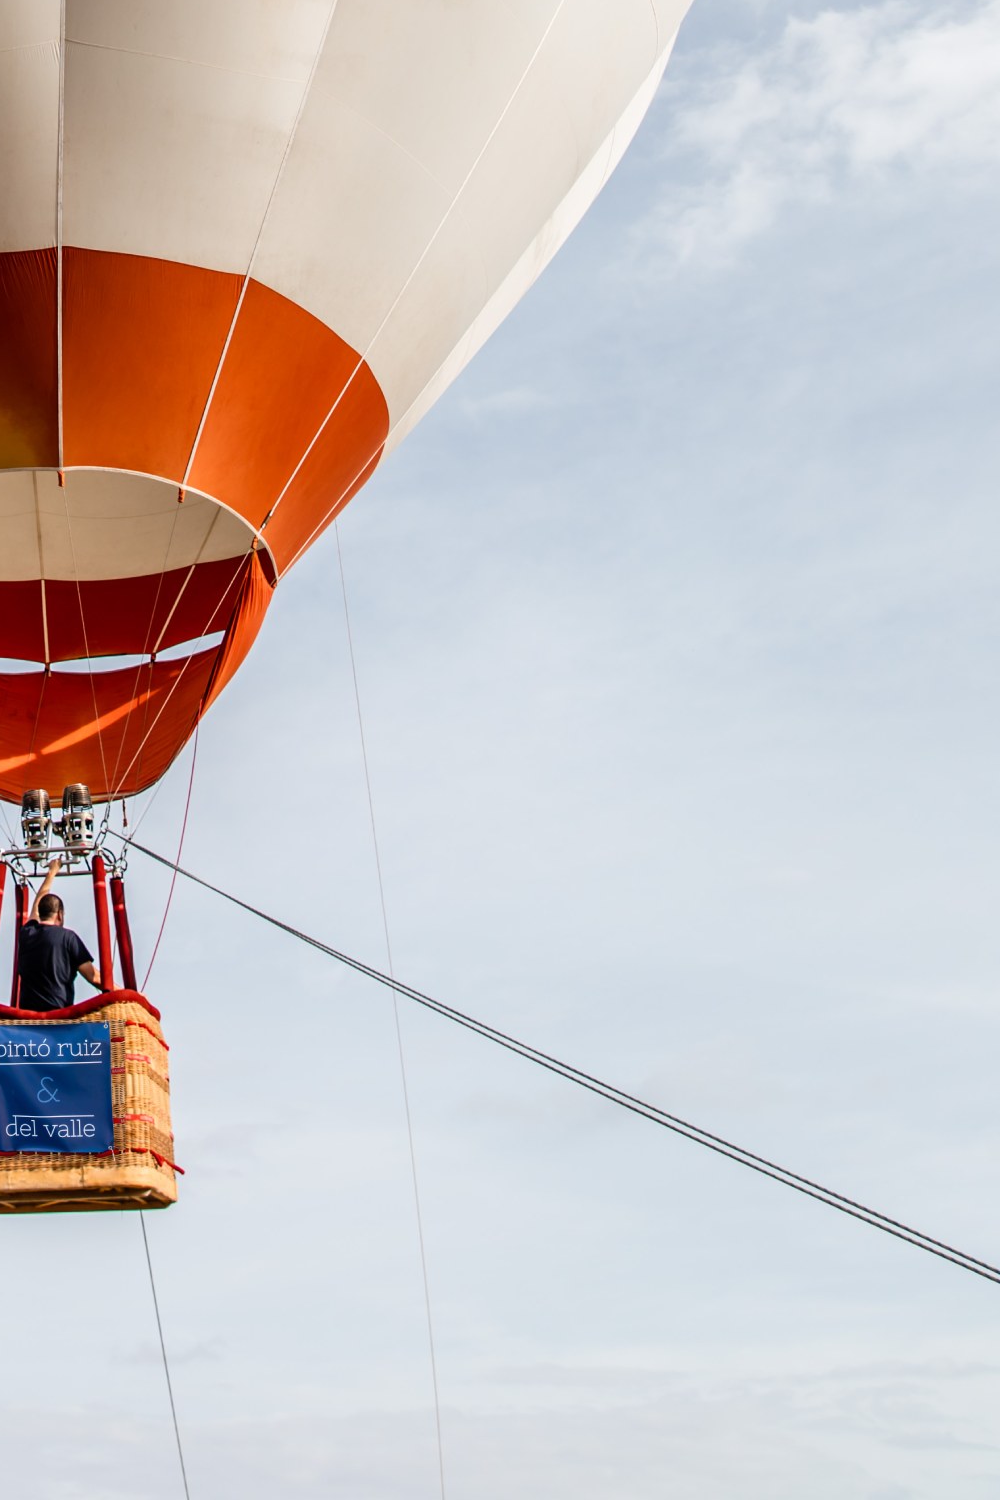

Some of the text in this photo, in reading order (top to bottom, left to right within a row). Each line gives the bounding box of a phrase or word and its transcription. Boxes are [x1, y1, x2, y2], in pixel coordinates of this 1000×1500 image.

[57, 1040, 102, 1057] ruiz
[37, 1076, 60, 1103] &
[5, 1115, 96, 1138] del valle
